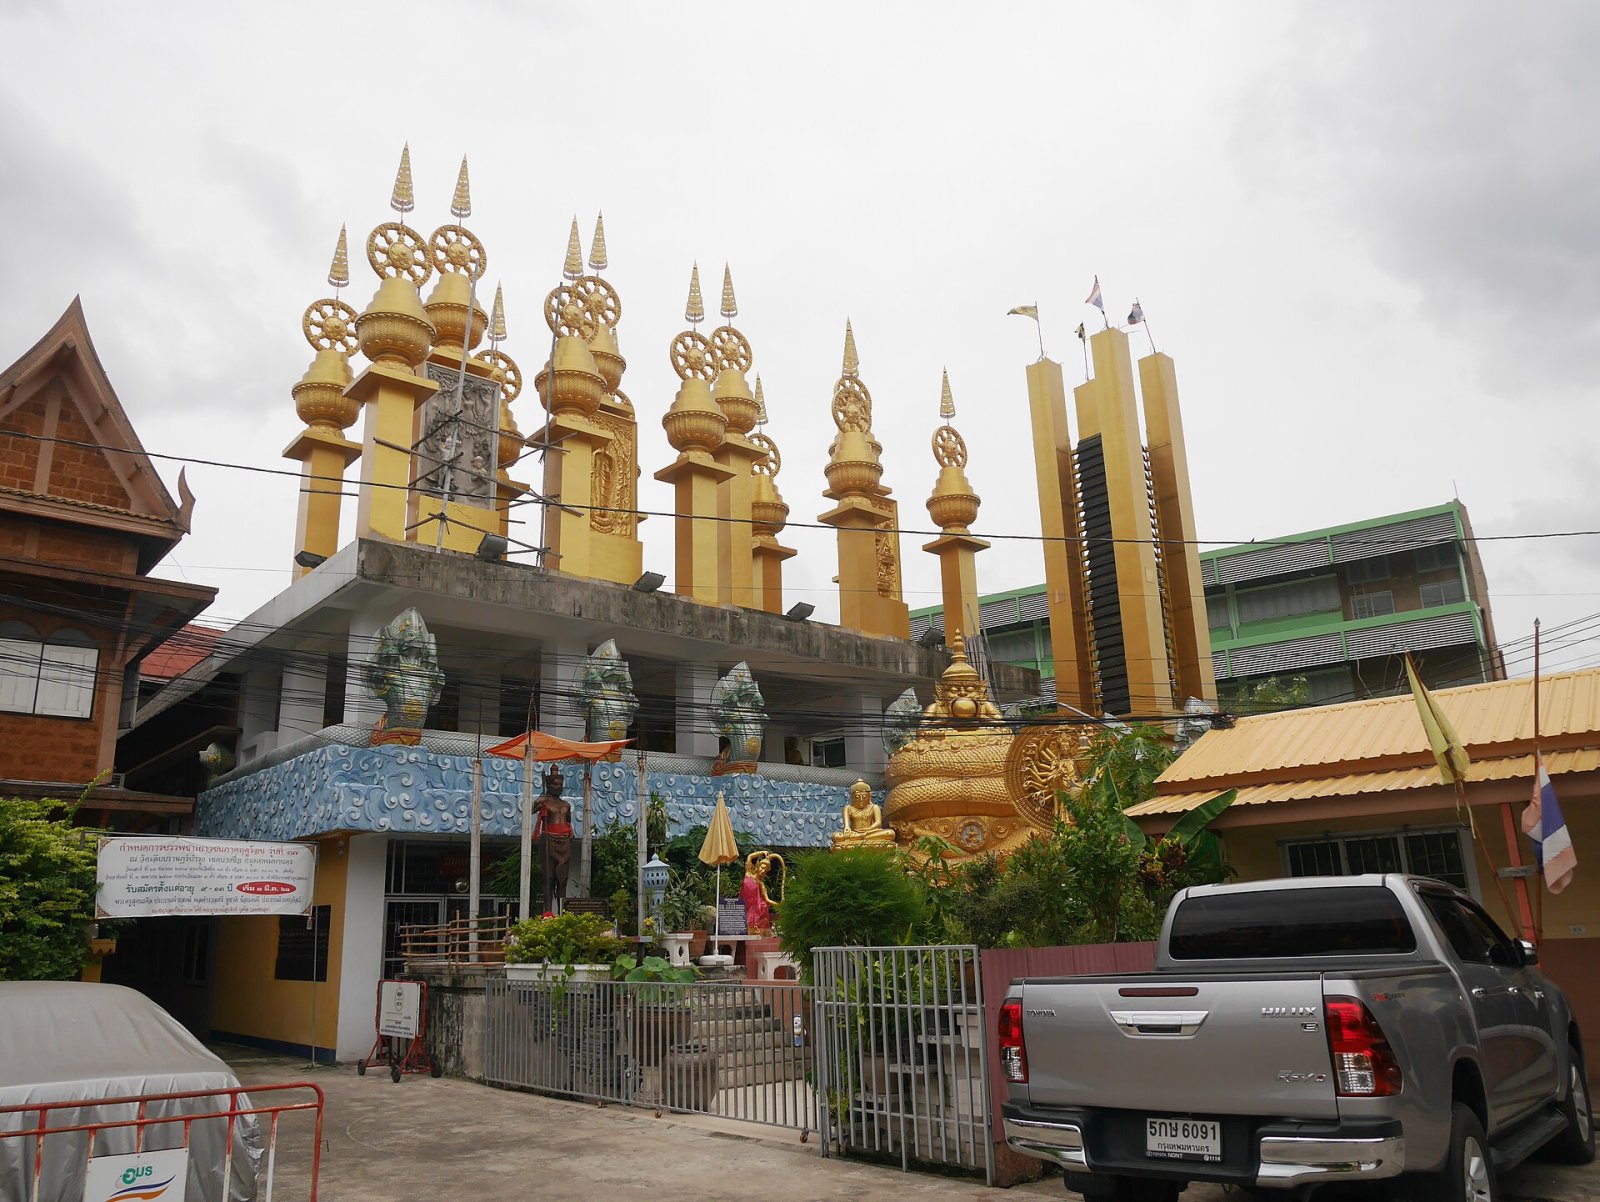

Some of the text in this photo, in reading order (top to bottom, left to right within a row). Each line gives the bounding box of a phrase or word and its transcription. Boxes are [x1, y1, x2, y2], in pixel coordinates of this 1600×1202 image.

[126, 881, 195, 895] รับสมัครตั้งแต่อายุ
[227, 883, 233, 892] ปี
[242, 883, 255, 891] เริ่ม
[1026, 1009, 1057, 1017] TOYOTA
[1261, 1006, 1317, 1017] HILUX
[1149, 1120, 1216, 1140] 5กษ 6091
[1157, 1142, 1210, 1152] กรุงเทพมหานคร
